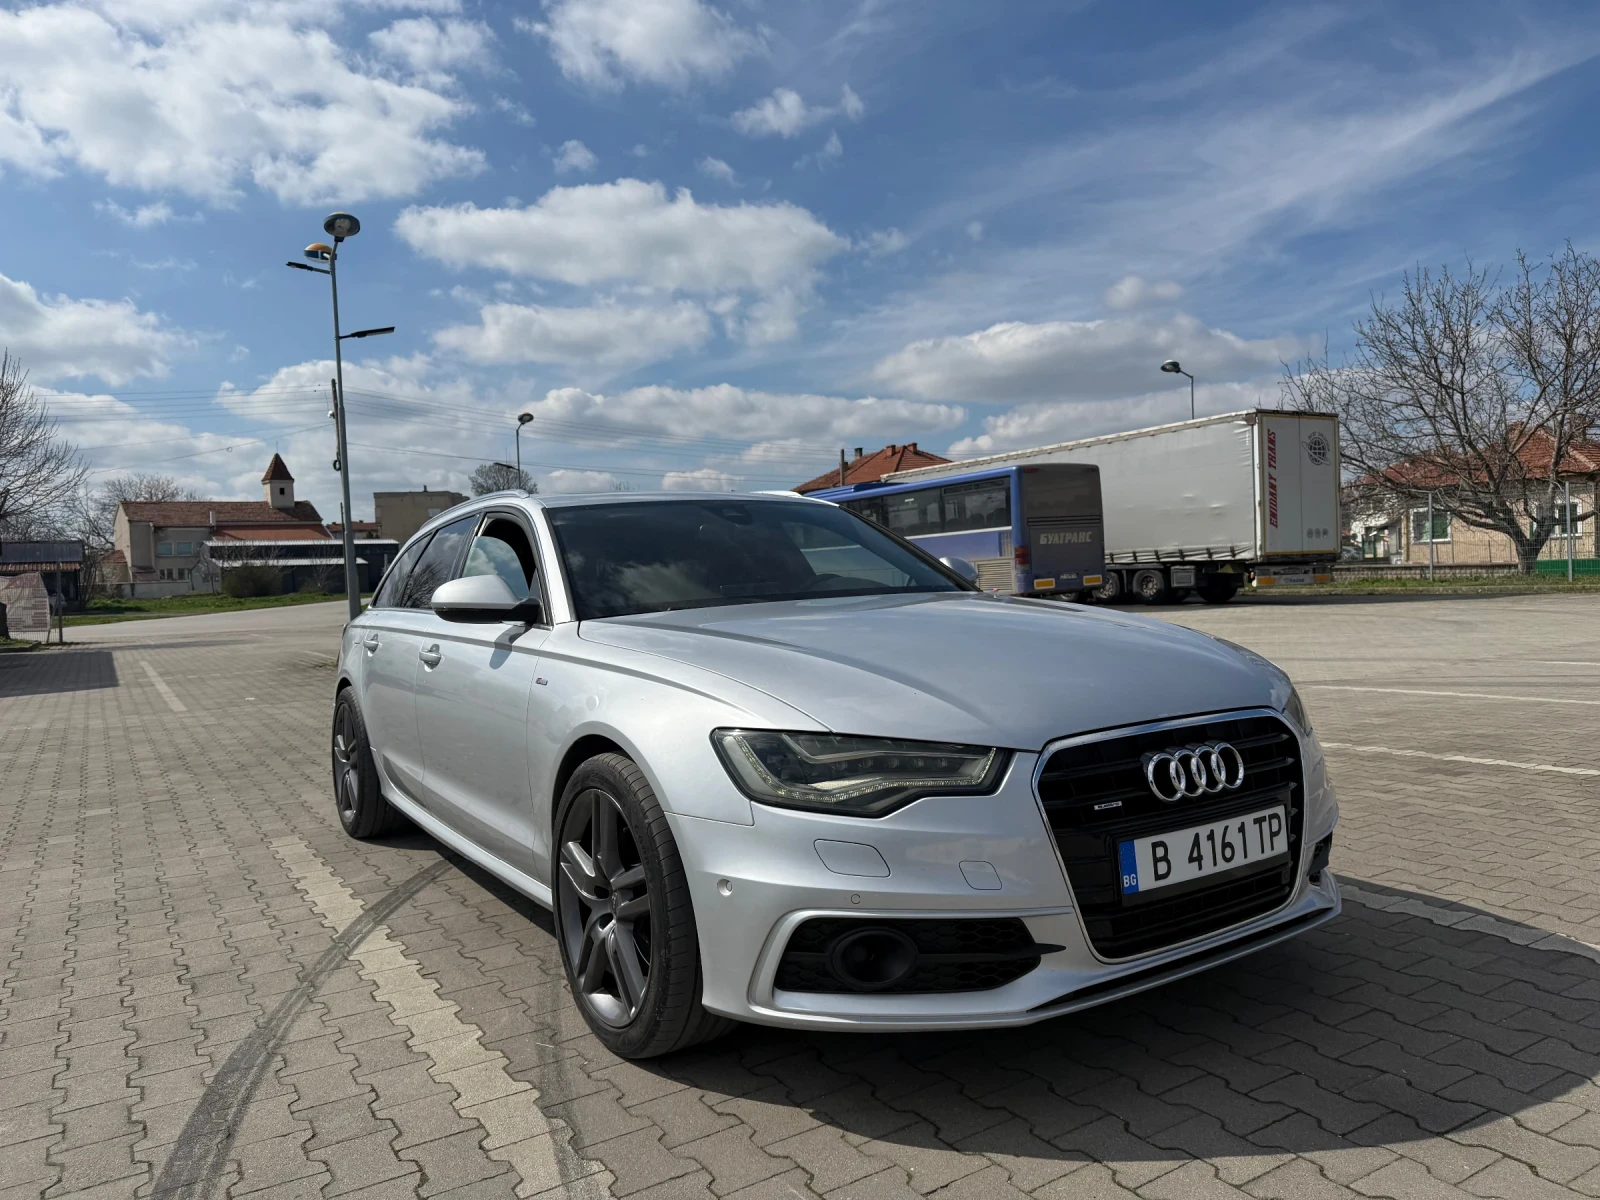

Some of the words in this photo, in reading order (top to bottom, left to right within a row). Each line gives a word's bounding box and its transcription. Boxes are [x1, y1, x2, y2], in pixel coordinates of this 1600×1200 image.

[1267, 428, 1277, 470] TRANS
[1039, 531, 1092, 545] БУЛТРАНС
[1151, 840, 1172, 882] B
[1187, 821, 1249, 871] 4161
[1252, 812, 1282, 854] TP
[1123, 873, 1137, 888] BG
